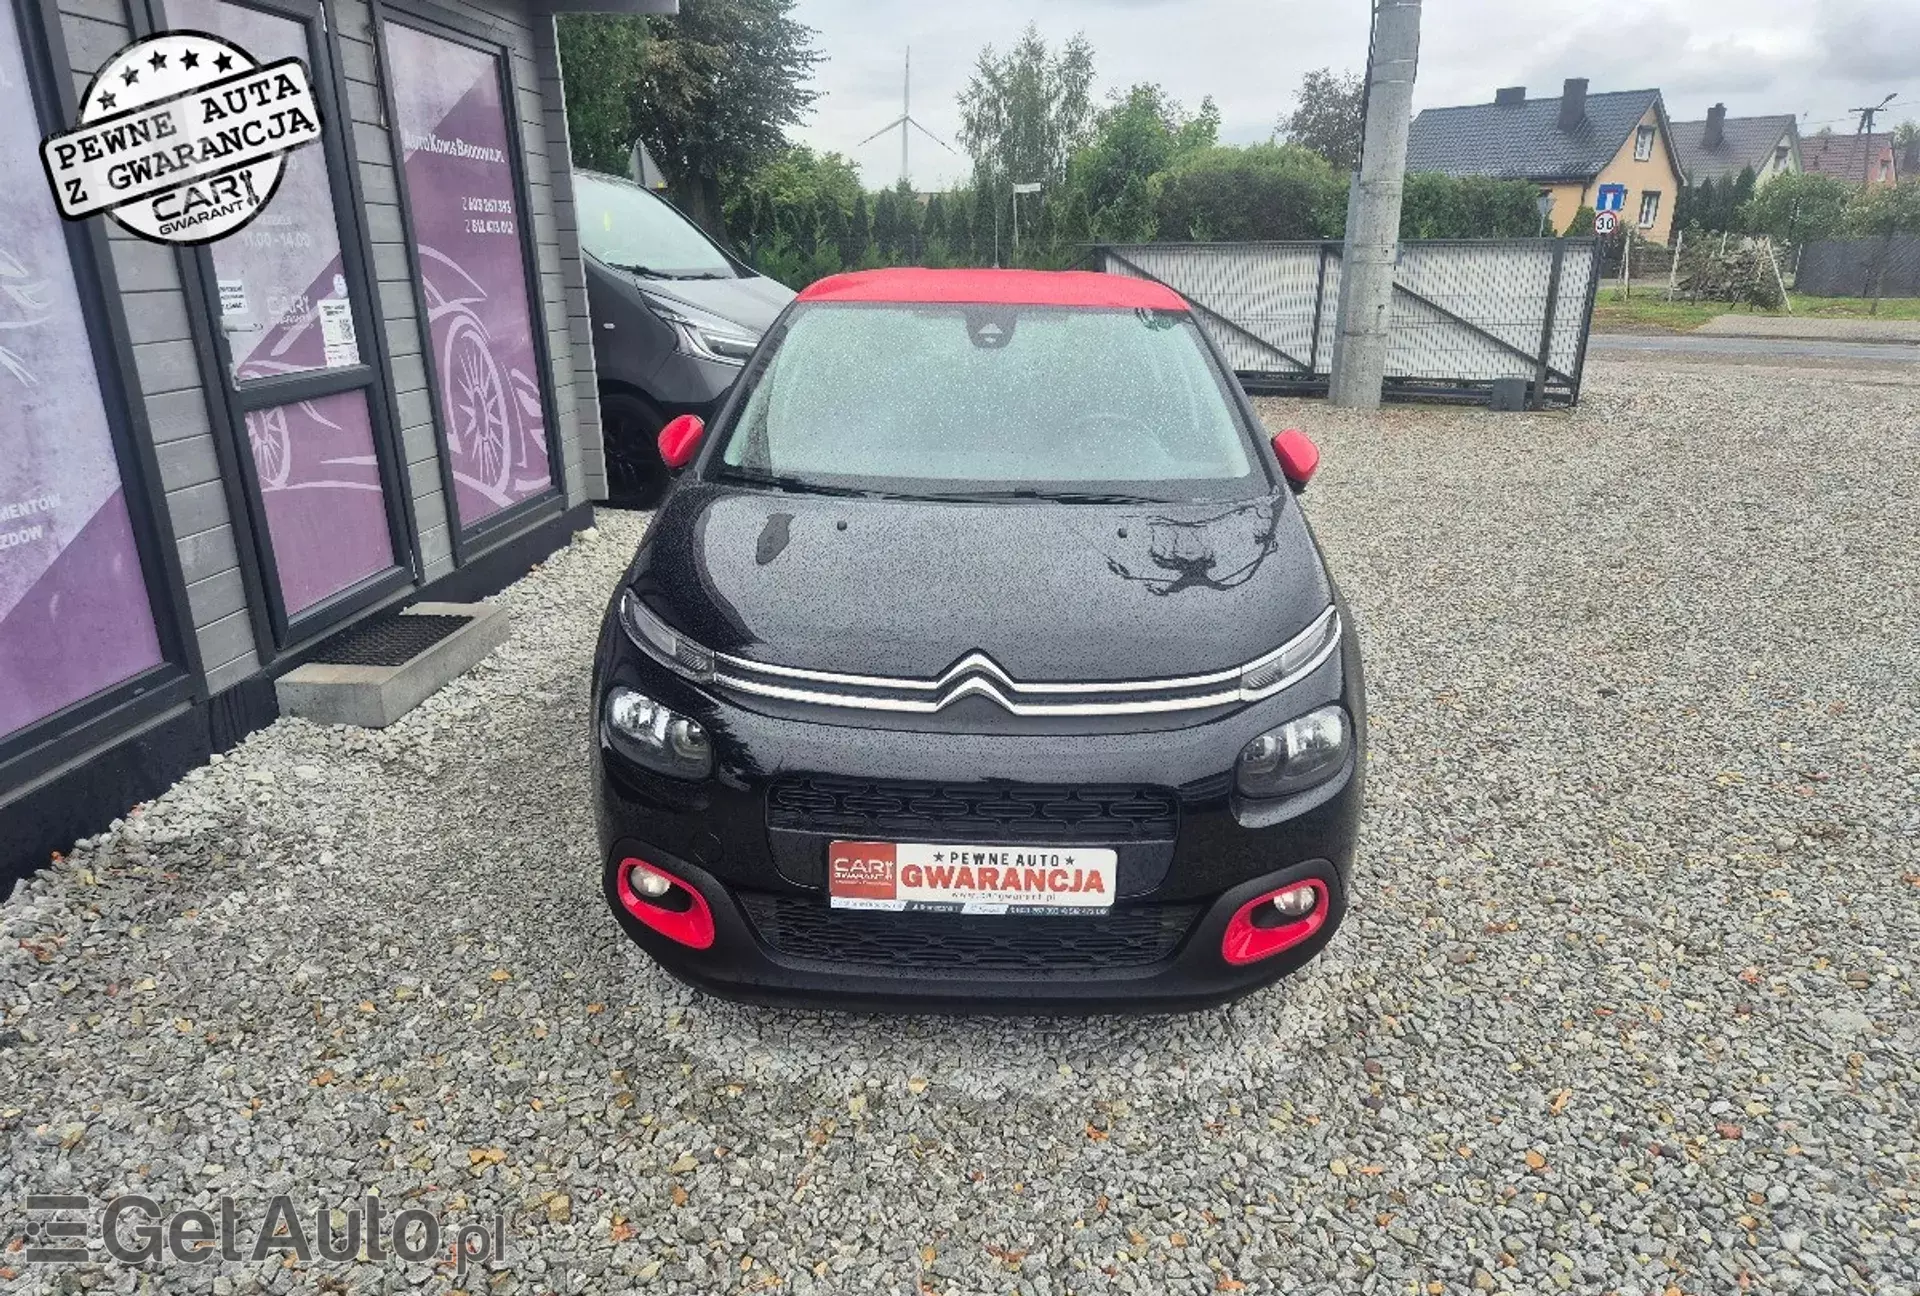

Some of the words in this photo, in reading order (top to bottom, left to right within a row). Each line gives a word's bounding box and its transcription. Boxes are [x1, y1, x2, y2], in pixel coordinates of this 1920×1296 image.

[1597, 217, 1614, 230] 30
[834, 857, 884, 873] CAR
[950, 851, 1009, 866] PEWNE
[1015, 854, 1059, 867] AUTO
[901, 864, 1105, 894] GWARANCJA
